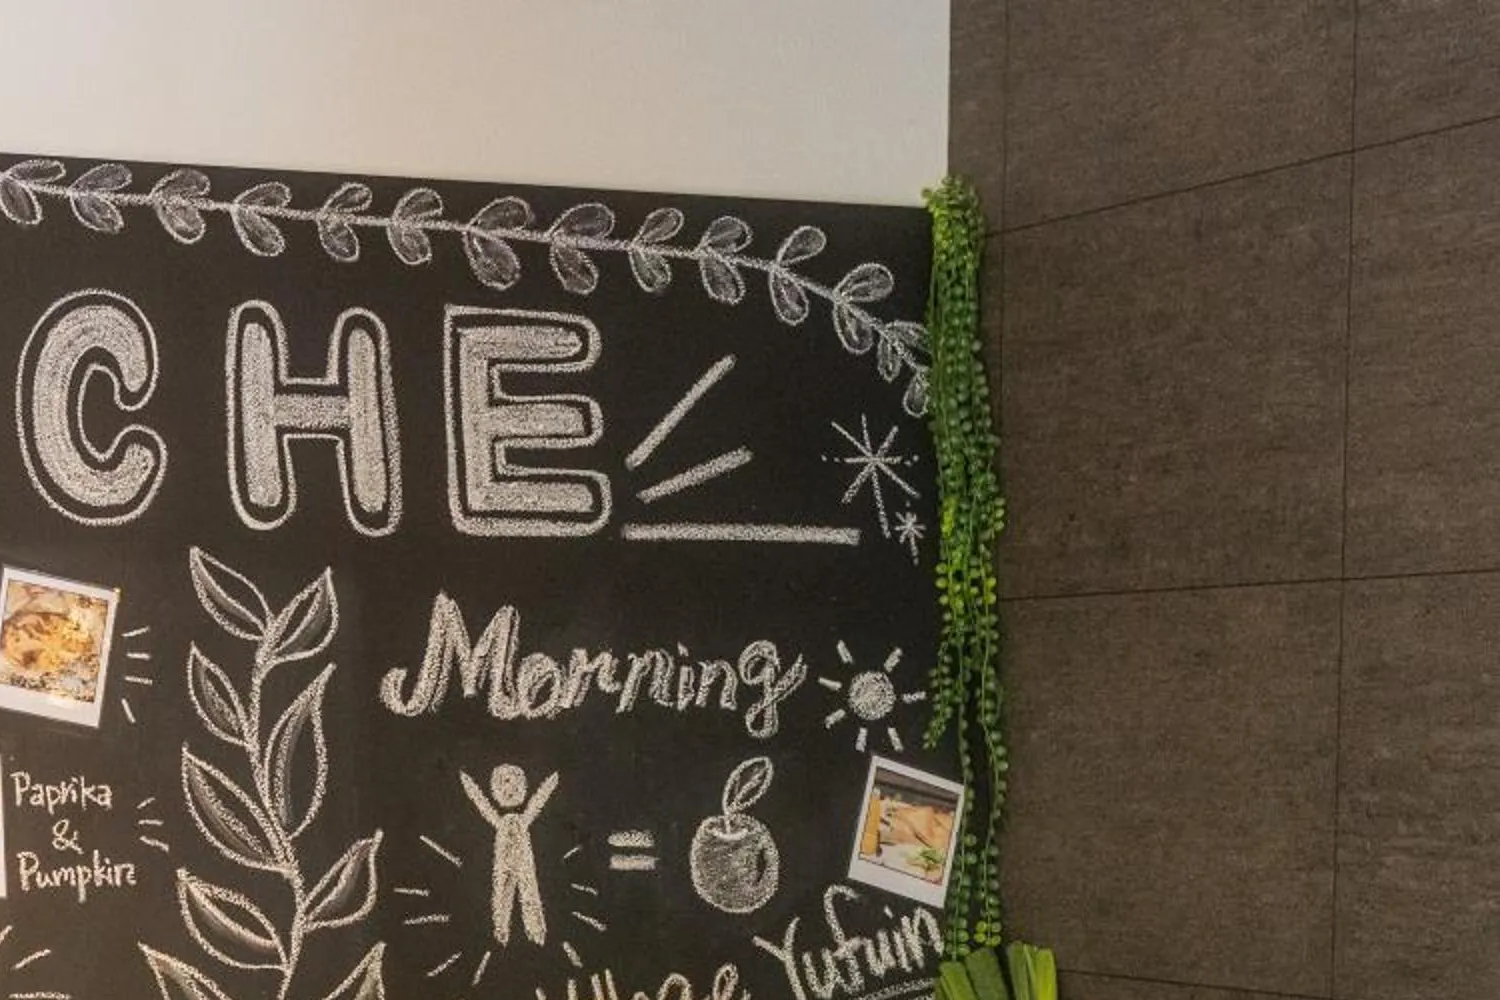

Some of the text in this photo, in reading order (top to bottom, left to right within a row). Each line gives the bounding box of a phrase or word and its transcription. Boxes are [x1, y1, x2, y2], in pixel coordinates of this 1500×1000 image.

[380, 590, 807, 738] Morning
[9, 771, 113, 815] Paprika
[51, 818, 85, 855] &
[15, 850, 137, 902] Pumpkin
